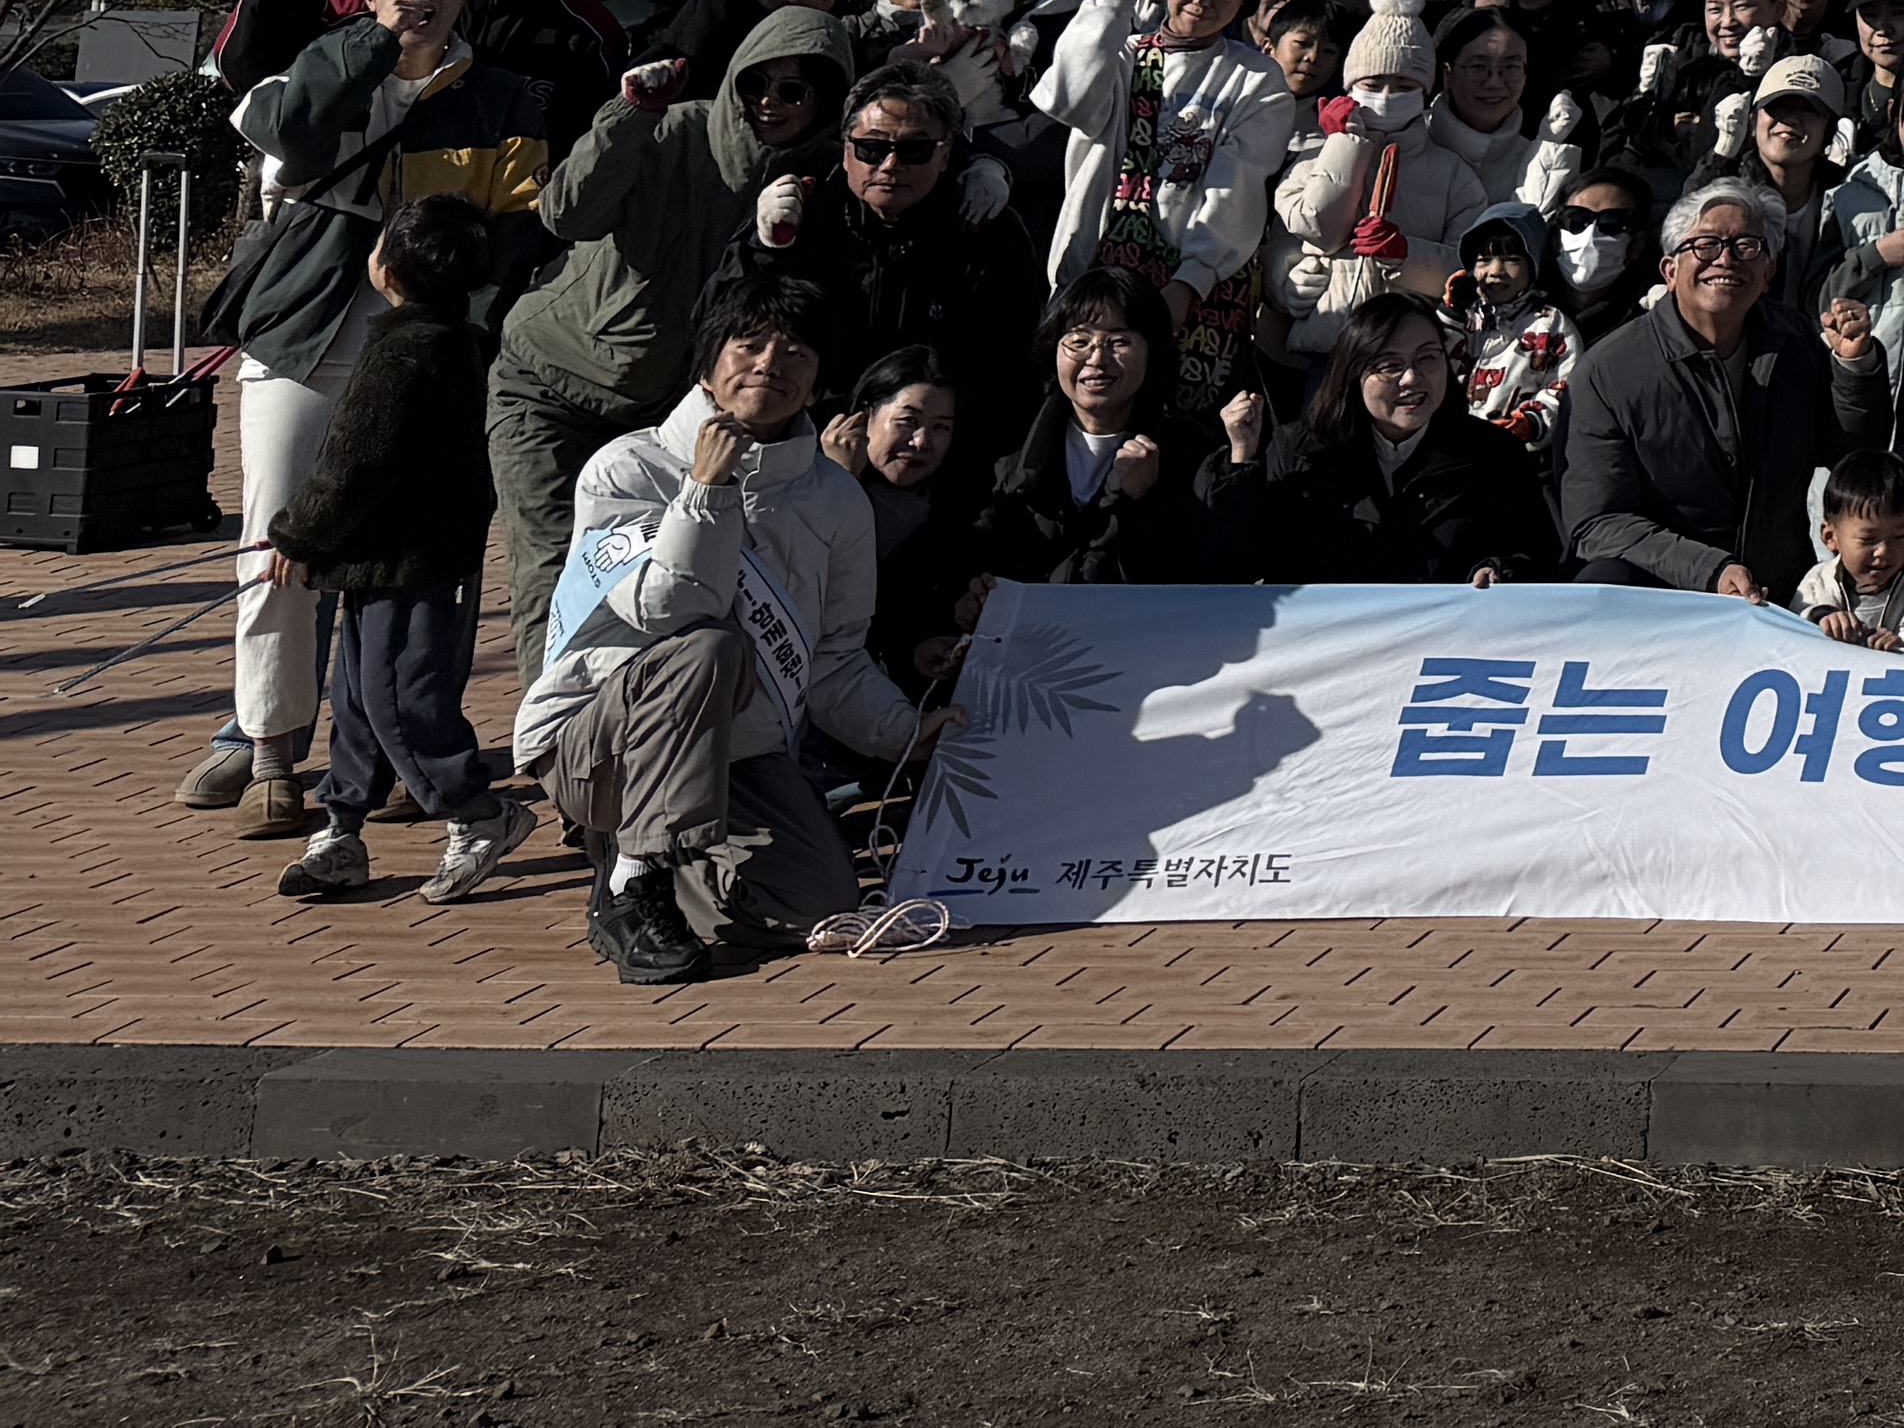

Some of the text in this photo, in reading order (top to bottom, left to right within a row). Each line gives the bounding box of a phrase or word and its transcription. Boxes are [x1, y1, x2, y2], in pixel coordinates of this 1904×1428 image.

[1391, 657, 1667, 777] 줍는
[946, 853, 1030, 895] Jeju
[1054, 853, 1293, 891] 제주특별자치도
